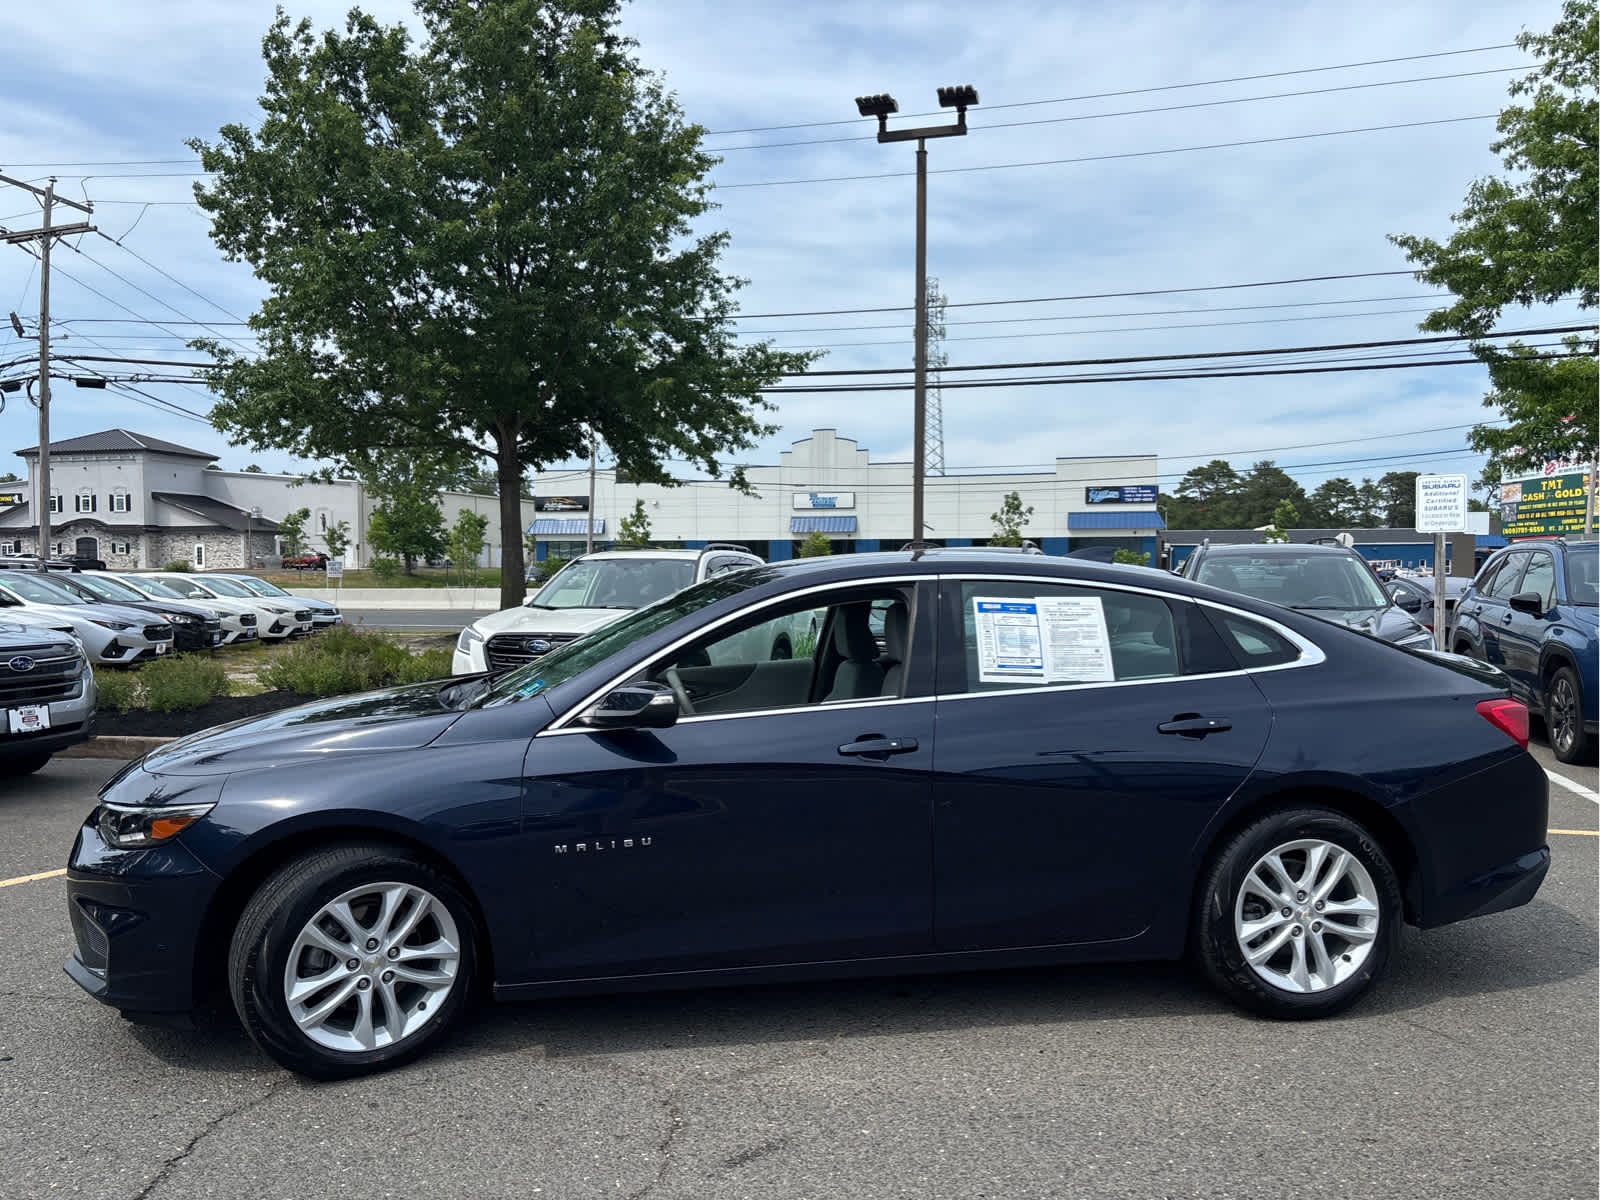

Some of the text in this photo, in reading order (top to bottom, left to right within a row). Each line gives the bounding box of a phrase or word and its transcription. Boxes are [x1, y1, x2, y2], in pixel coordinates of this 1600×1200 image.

[1541, 479, 1563, 491] TMT
[1522, 492, 1545, 502] CASH
[1555, 489, 1582, 499] GOLD
[554, 837, 651, 853] MALIBU
